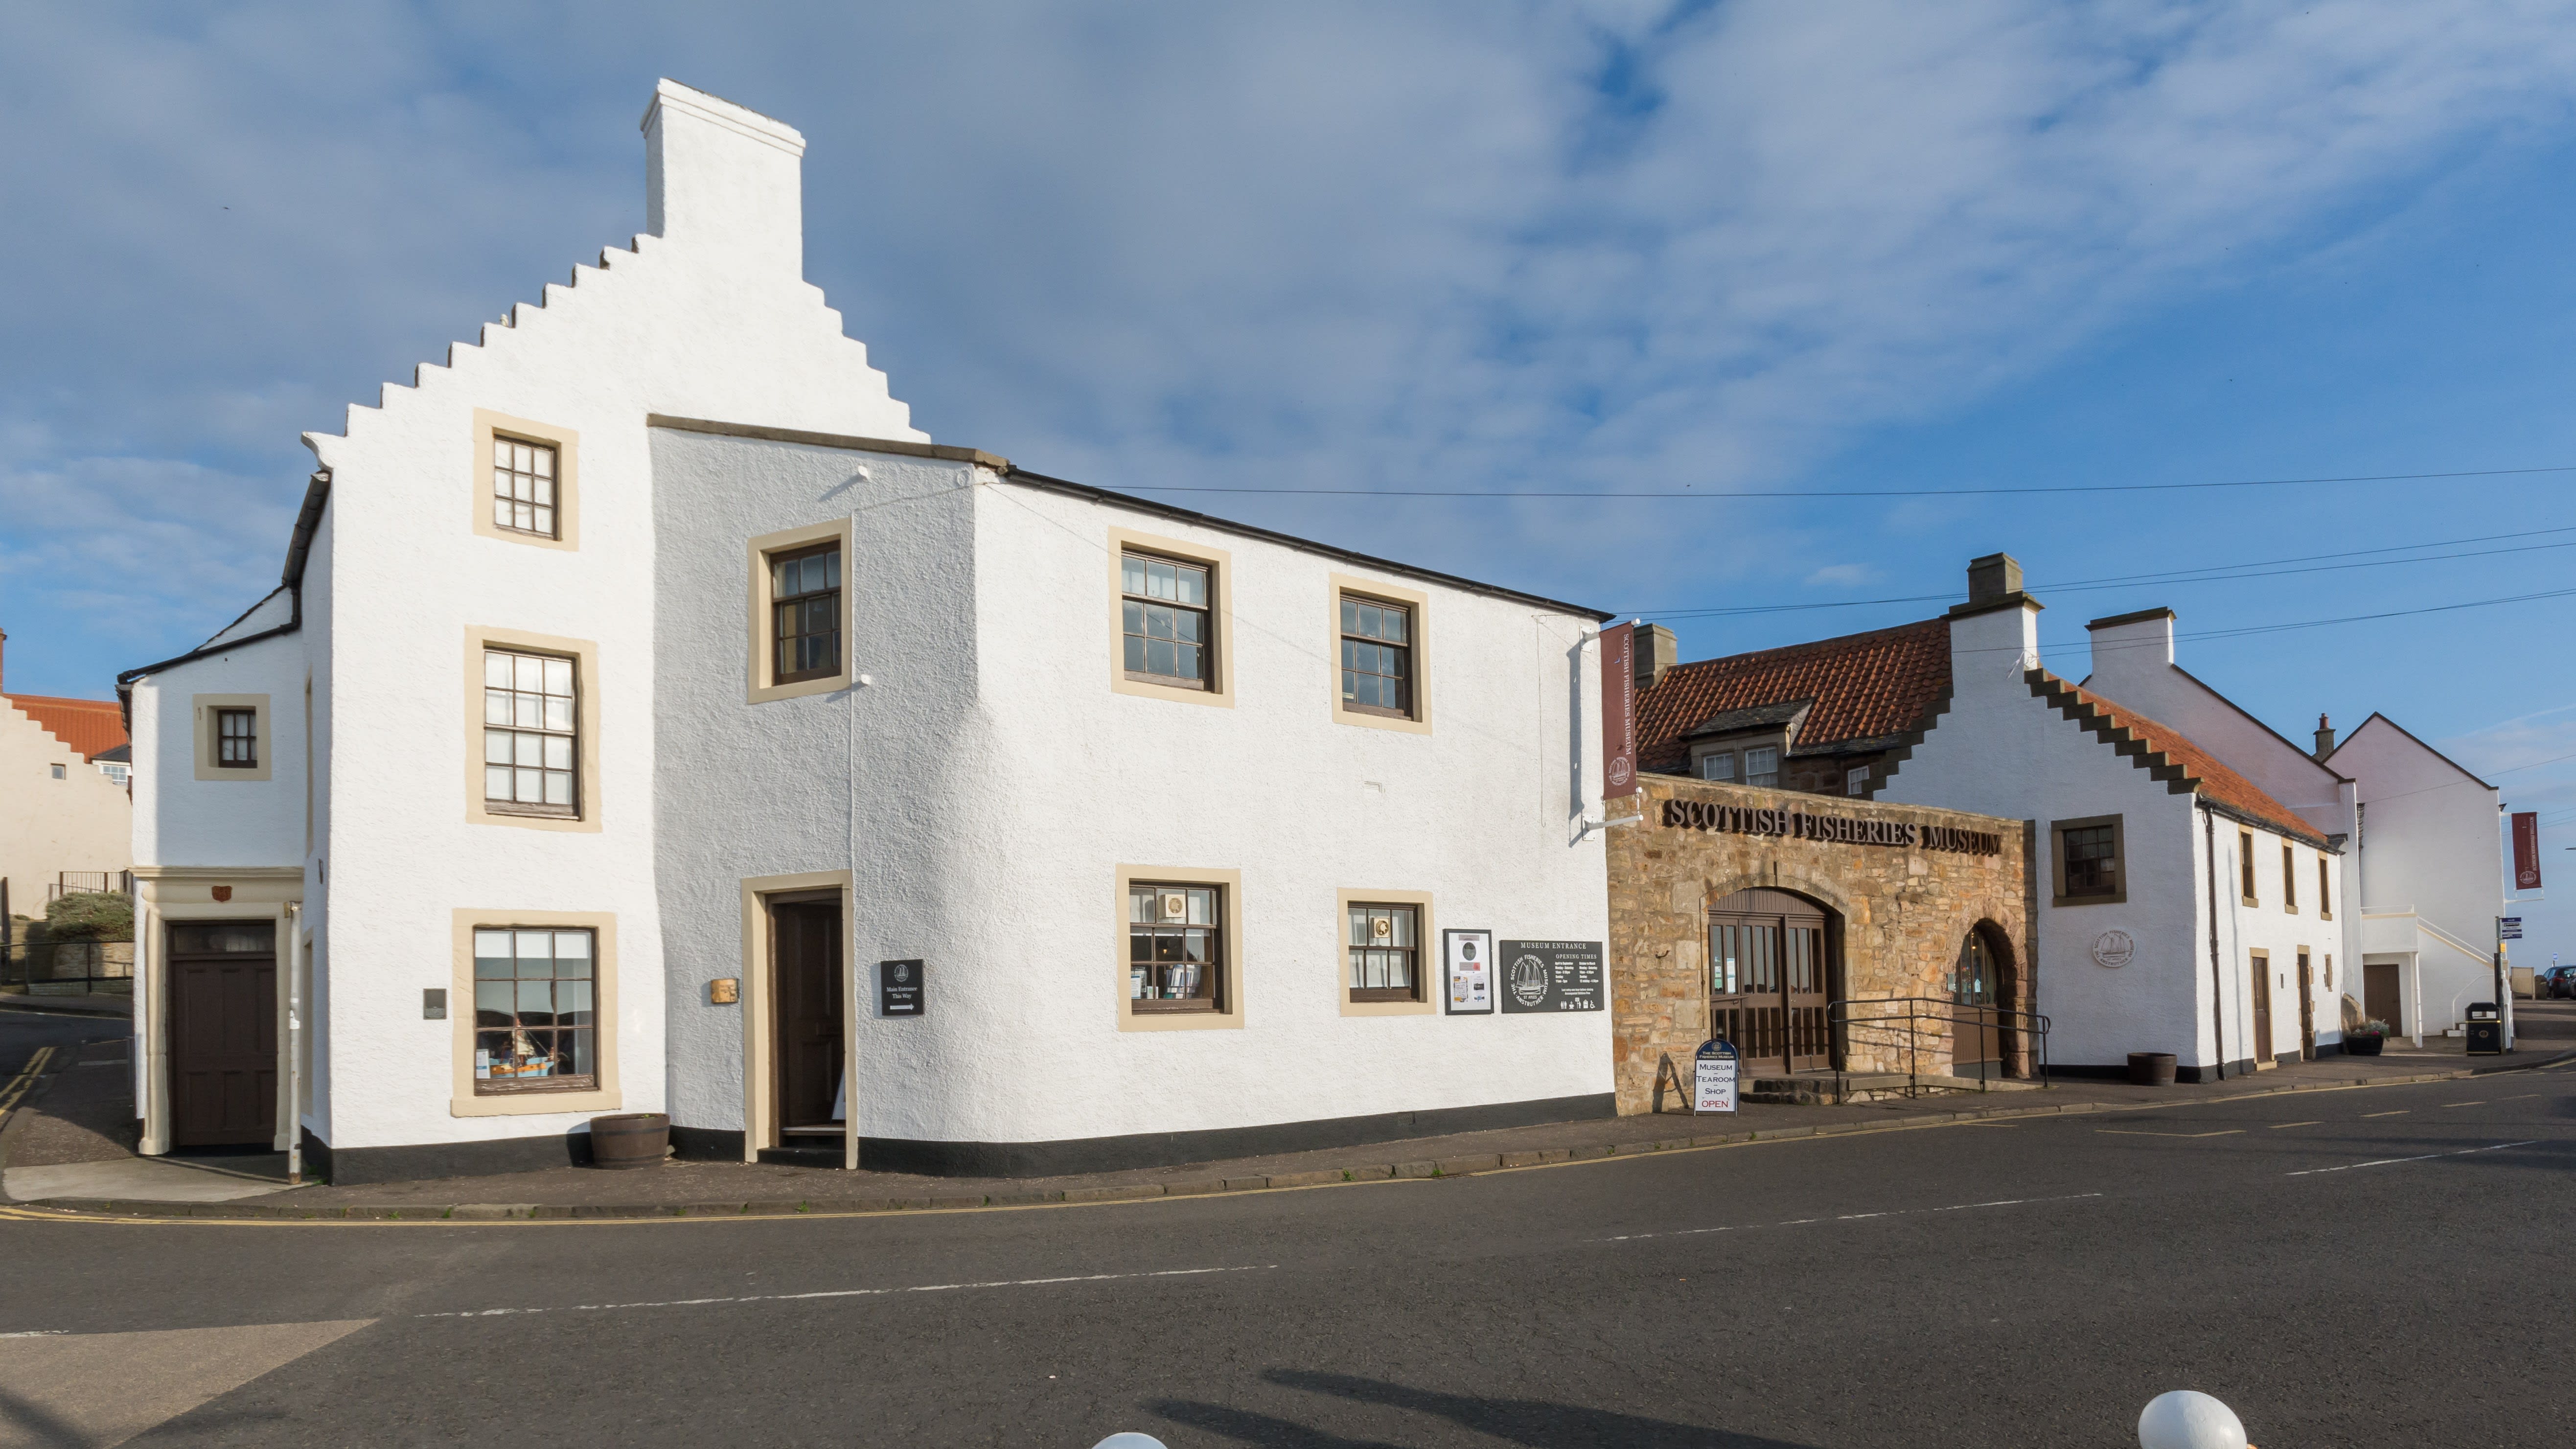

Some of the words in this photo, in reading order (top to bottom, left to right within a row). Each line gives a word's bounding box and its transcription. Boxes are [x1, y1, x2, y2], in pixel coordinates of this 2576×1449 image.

[1669, 798, 1790, 834] SCOTTISH
[1800, 812, 1917, 845] FISHERIES
[1929, 826, 2002, 855] MUSEUM
[1510, 956, 1523, 981] SCOTTISH
[1524, 954, 1544, 968] FISHERIES
[1516, 995, 1544, 1007] ANSTRUTHER
